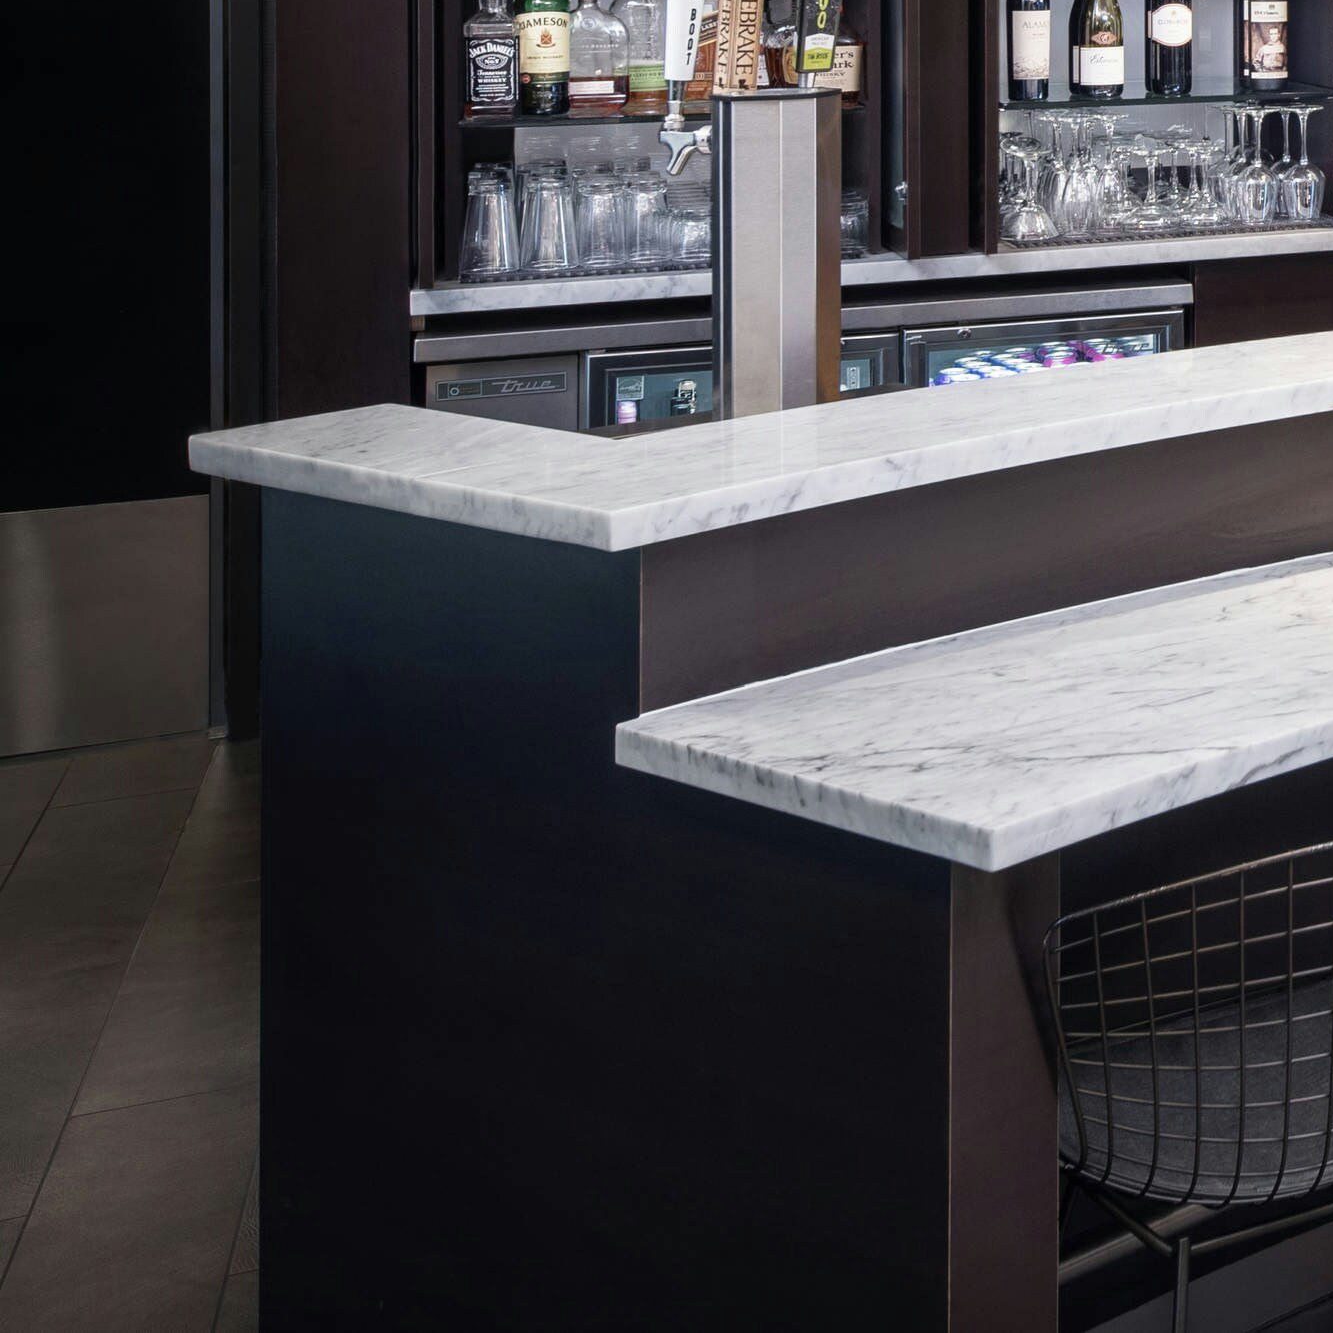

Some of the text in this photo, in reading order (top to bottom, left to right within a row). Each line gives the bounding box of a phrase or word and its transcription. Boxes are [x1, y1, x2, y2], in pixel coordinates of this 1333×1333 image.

[519, 17, 568, 30] JAMESON
[686, 8, 697, 66] BOOT
[469, 46, 486, 58] JACK
[834, 50, 854, 58] er's
[833, 60, 853, 68] ark
[492, 378, 556, 394] true
